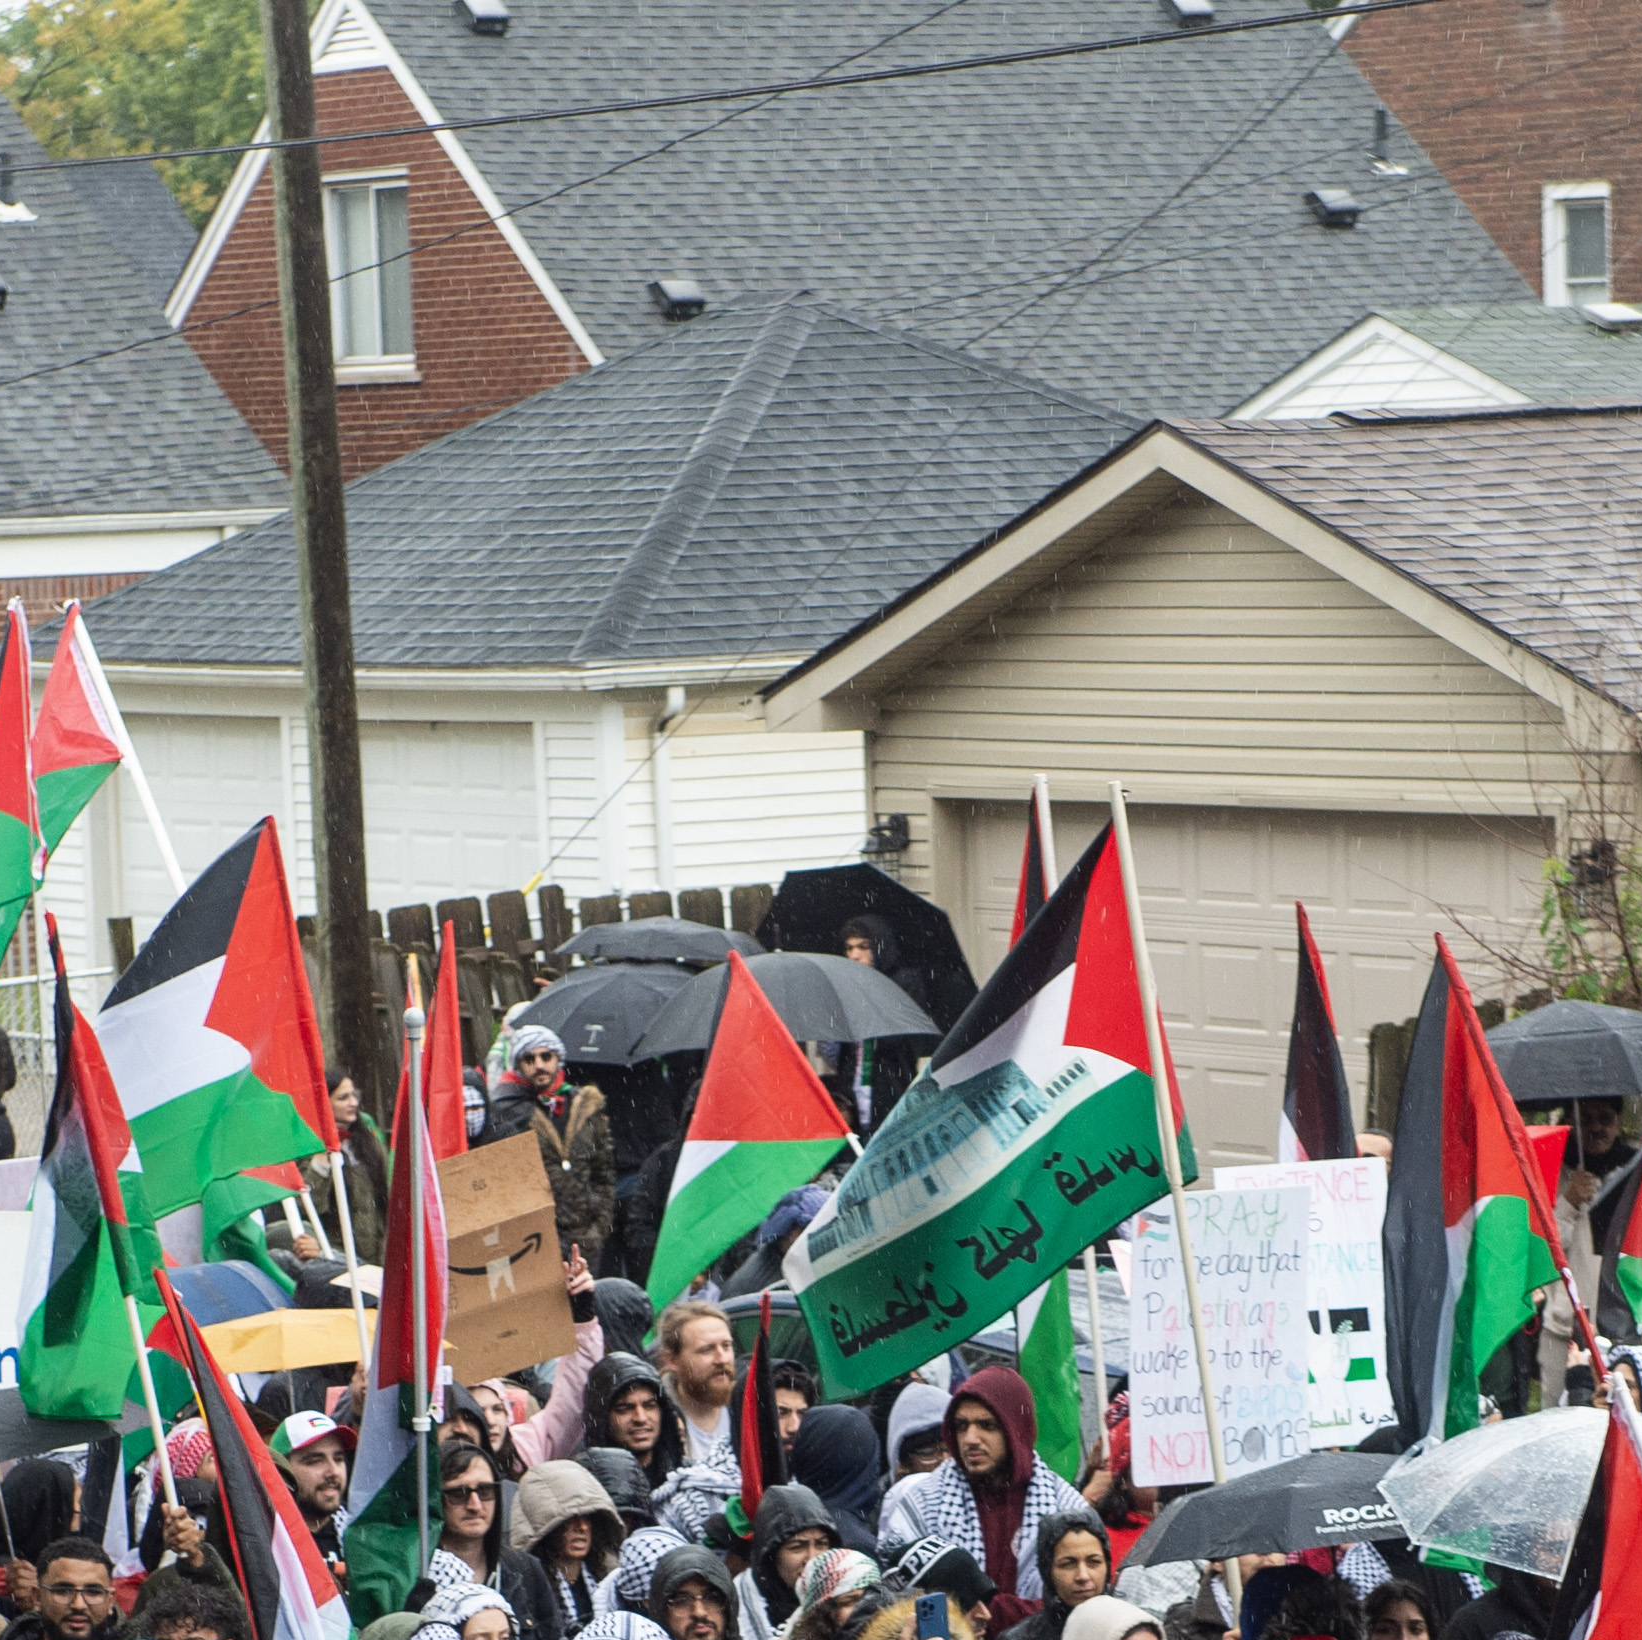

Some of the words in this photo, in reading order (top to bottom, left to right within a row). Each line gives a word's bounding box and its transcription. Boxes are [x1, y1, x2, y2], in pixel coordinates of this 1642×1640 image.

[1185, 1194, 1287, 1236] PRAY
[1139, 1243, 1175, 1280] for
[1214, 1240, 1251, 1292] day
[1256, 1240, 1302, 1288] that
[1133, 1345, 1189, 1380] wake
[1221, 1345, 1241, 1371] to
[1250, 1346, 1282, 1380] the
[1237, 1384, 1303, 1418] BIRDS
[1148, 1431, 1209, 1473] NOT
[1223, 1418, 1309, 1466] BOMBS
[1322, 1503, 1394, 1525] ROCK
